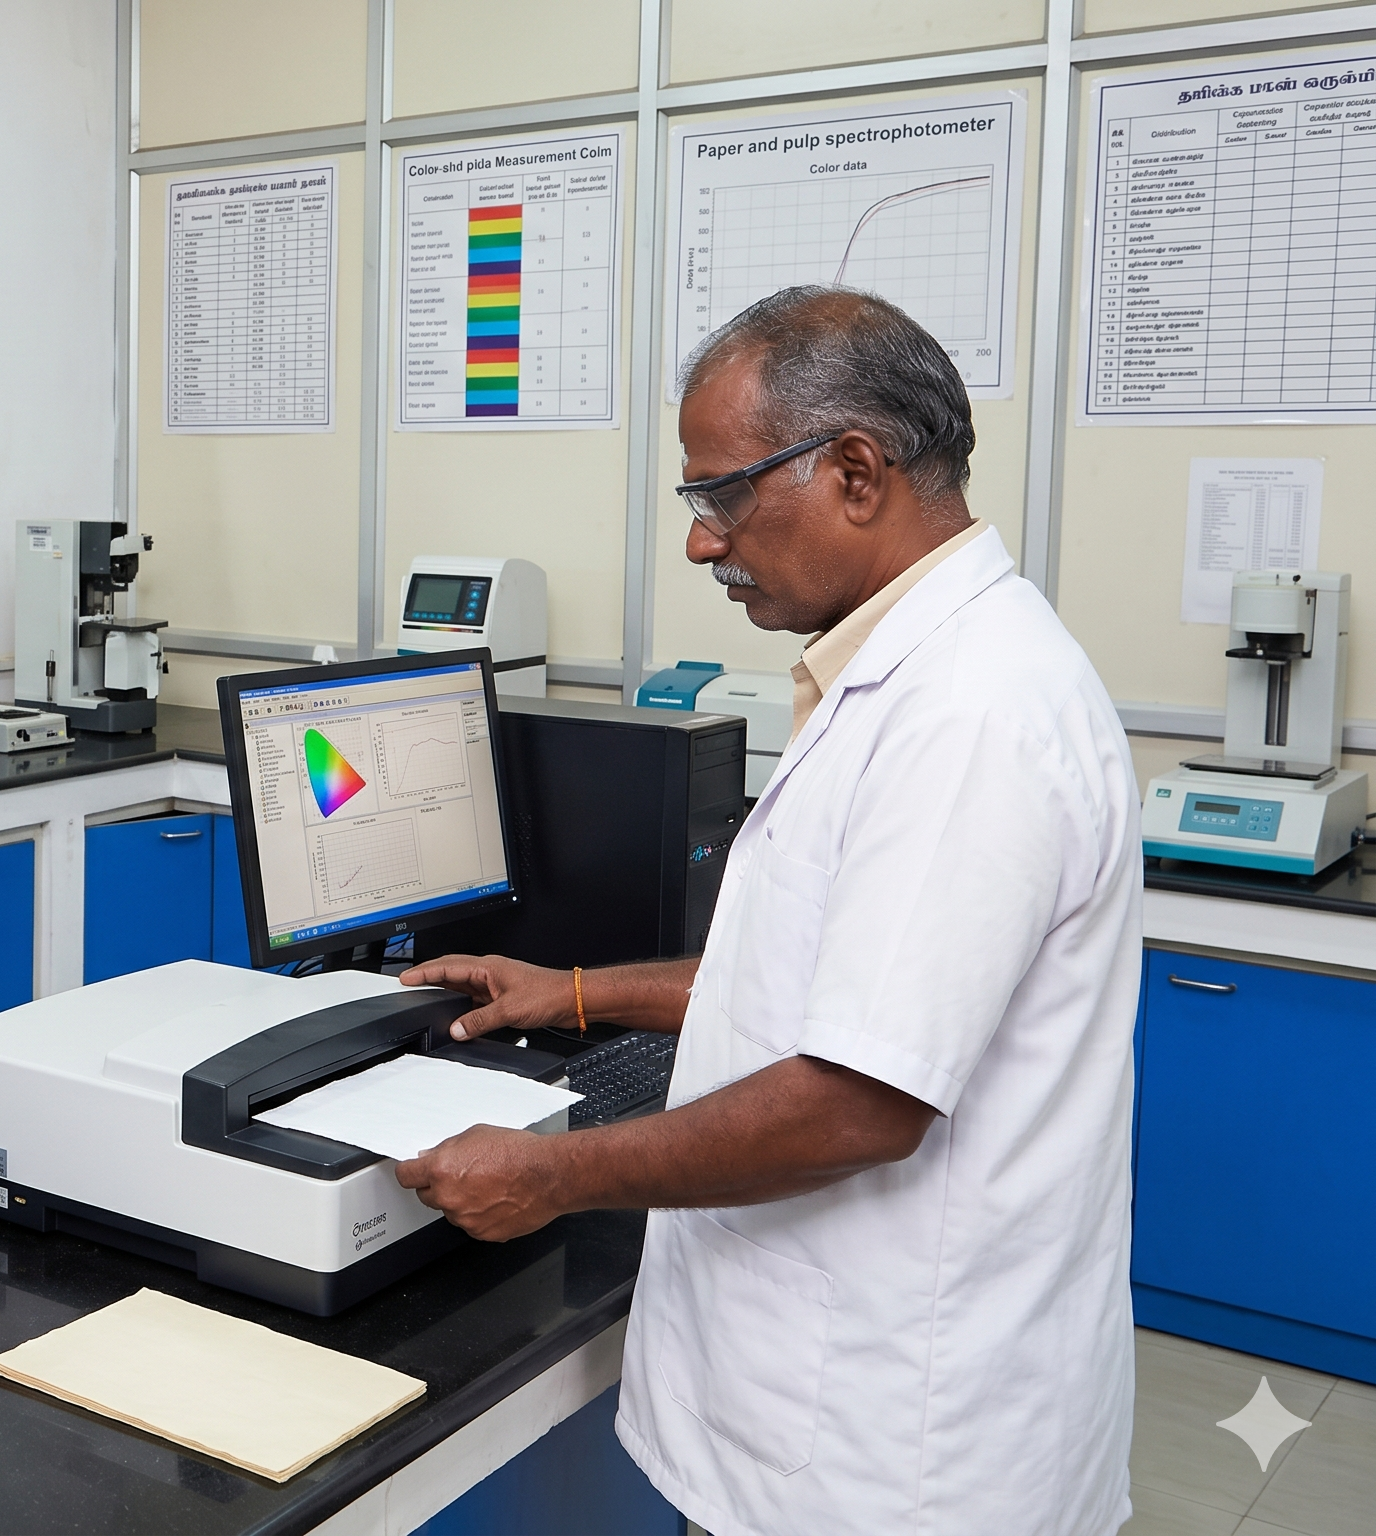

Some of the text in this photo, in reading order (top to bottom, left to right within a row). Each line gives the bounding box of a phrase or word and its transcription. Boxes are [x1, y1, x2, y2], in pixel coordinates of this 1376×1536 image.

[697, 117, 995, 160] Paper and pulp spectrophotometer
[409, 160, 464, 177] Color-shd
[466, 158, 492, 173] pida
[496, 148, 577, 168] Measurement
[810, 160, 867, 174] Color data
[976, 348, 992, 357] 200
